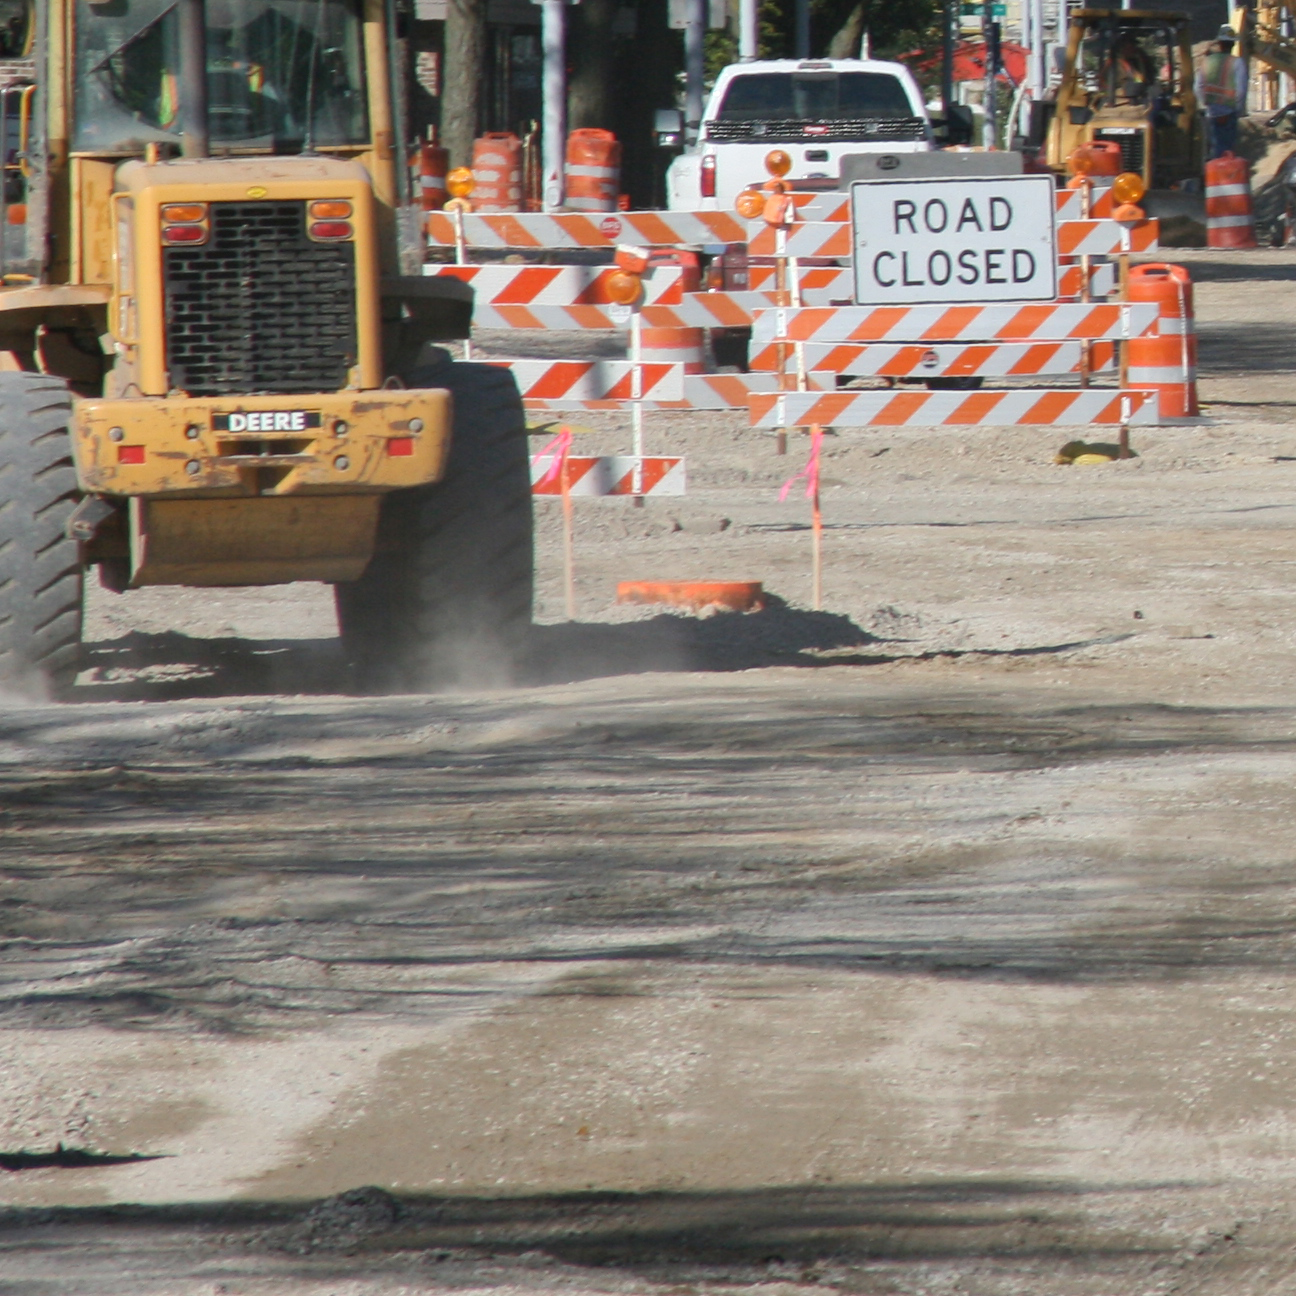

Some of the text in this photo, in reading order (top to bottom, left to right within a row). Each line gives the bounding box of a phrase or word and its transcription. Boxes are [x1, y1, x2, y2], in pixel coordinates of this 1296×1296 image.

[894, 196, 1012, 235] ROAD
[873, 249, 1036, 288] CLOSED
[228, 411, 305, 432] DEERE
